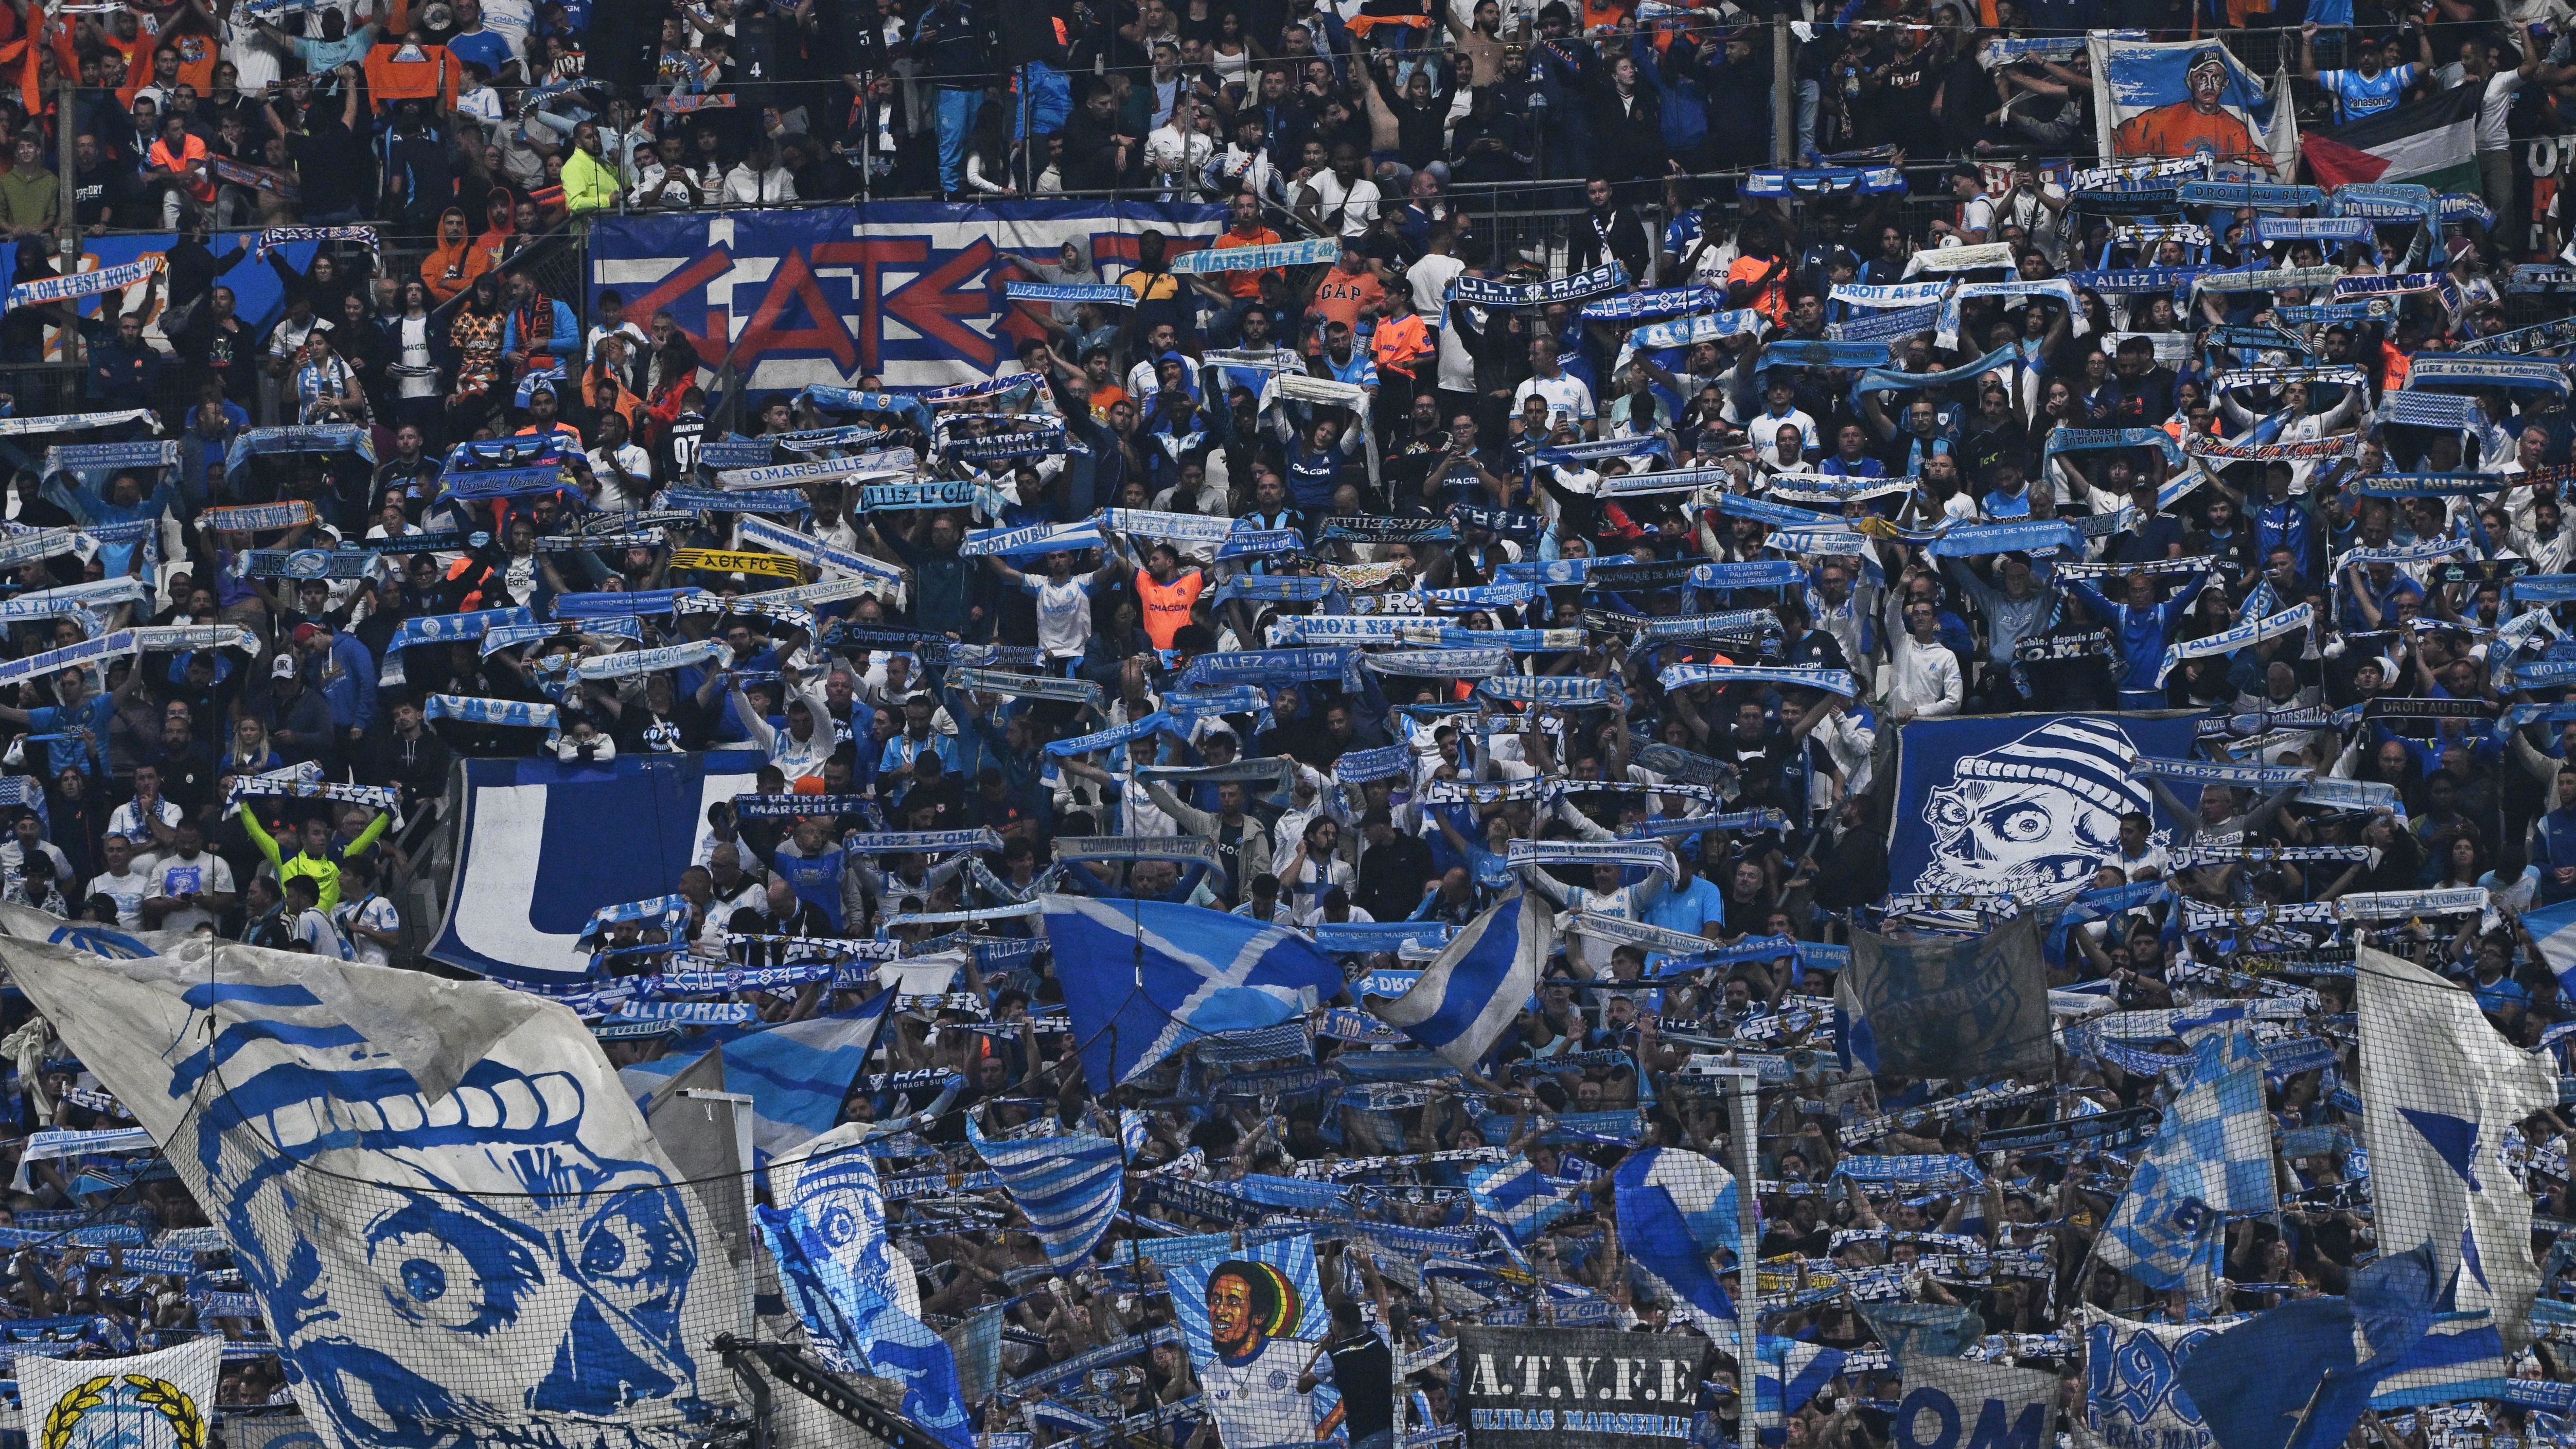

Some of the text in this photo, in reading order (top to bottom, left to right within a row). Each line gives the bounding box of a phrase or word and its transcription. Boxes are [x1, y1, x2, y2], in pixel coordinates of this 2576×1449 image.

[859, 30, 870, 45] 3
[750, 62, 761, 77] 4
[2349, 97, 2391, 108] Panasonic
[2196, 186, 2312, 201] DROIT AU BUT
[2349, 202, 2399, 217] ALLEZ
[2263, 221, 2358, 233] OLYMPIQUE de MARSEILLE
[1193, 242, 1316, 273] MARSEILLE
[105, 262, 140, 289] NOUS
[2270, 266, 2339, 278] de Marseille
[2096, 275, 2149, 286] ALLEZ
[1321, 285, 1361, 301] GAP
[1459, 281, 1610, 303] MARSEILLE VIRAGE SUD
[1656, 291, 1688, 309] 84
[1897, 312, 1913, 320] JAMAIS
[1921, 305, 1937, 314] BATTRE
[2287, 309, 2319, 320] Allez
[2210, 333, 2301, 349] DE MARSEILLE
[673, 423, 703, 433] AUBAMEYANG
[976, 433, 1033, 445] ULTRAS
[674, 435, 701, 473] 97
[963, 444, 1049, 458] MARSEILLE
[1542, 445, 1593, 459] OLYMPIQUE
[1611, 439, 1661, 451] MARSEILLE
[751, 458, 864, 481] O.MARSEILLE
[1292, 463, 1308, 475] CMA
[457, 473, 551, 492] Marseille Marseille
[2367, 478, 2417, 491] DROIT
[2424, 479, 2446, 490] AU
[861, 481, 976, 510] ALLEZ L'OM
[589, 514, 633, 532] Olympique
[652, 508, 693, 518] Marseille
[1327, 516, 1450, 533] MARSEILLE
[2081, 515, 2117, 536] MARSEILLE
[1339, 532, 1437, 542] OLYMPIQUE
[1944, 529, 2001, 541] OLYMPIQUE
[2019, 521, 2077, 534] MARSEILLE
[372, 540, 460, 552] MARSEILLE
[968, 525, 1053, 555] DROIT AU BUT
[1235, 535, 1247, 544] ON
[1242, 538, 1290, 552] ALLEZ L'OM
[252, 554, 364, 577] ALLEZ MARSEILLE
[750, 558, 770, 570] FC
[1582, 558, 1610, 569] ALLEZ
[2218, 561, 2239, 570] CGM
[508, 578, 527, 586] Eats
[1599, 570, 1650, 582] OLYMPIQUE
[1484, 582, 1527, 595] OLYMPIQUE
[1492, 588, 1533, 602] MARSEILLE
[1649, 614, 1752, 634] OLYMPIQUE MARSEILLE
[2189, 604, 2309, 651] ALLEZ L'OM
[398, 635, 451, 646] OLYMPIQUE
[854, 628, 919, 642] Olympique de
[34, 639, 105, 668] MAGNIFIQUE
[603, 648, 681, 672] ALLEZ L'OM
[1210, 652, 1337, 670] ALLEZ L'OM
[1176, 692, 1203, 700] OLYMPIQUE
[1212, 688, 1239, 698] MARSEILLE
[1202, 705, 1226, 714] SALZBURG
[2383, 702, 2479, 714] DROIT AU BUT
[750, 804, 851, 815] MARSEILLE
[1081, 838, 1216, 859] COMMANDO 84
[1511, 844, 1665, 858] A JAMAIS LES PREMIERS
[1592, 918, 1715, 952] OLYMPIQUE MARSEILLE
[989, 941, 1027, 961] ALLEZ
[755, 967, 792, 987] 84
[1335, 1016, 1361, 1037] SUD
[33, 1132, 76, 1142] OLYMPIQUE
[91, 1127, 133, 1137] MARSEILLE
[60, 1140, 110, 1153] DROIT AU BUT
[1471, 1408, 1555, 1432] ULTRAS
[1896, 1387, 2046, 1449] OM
